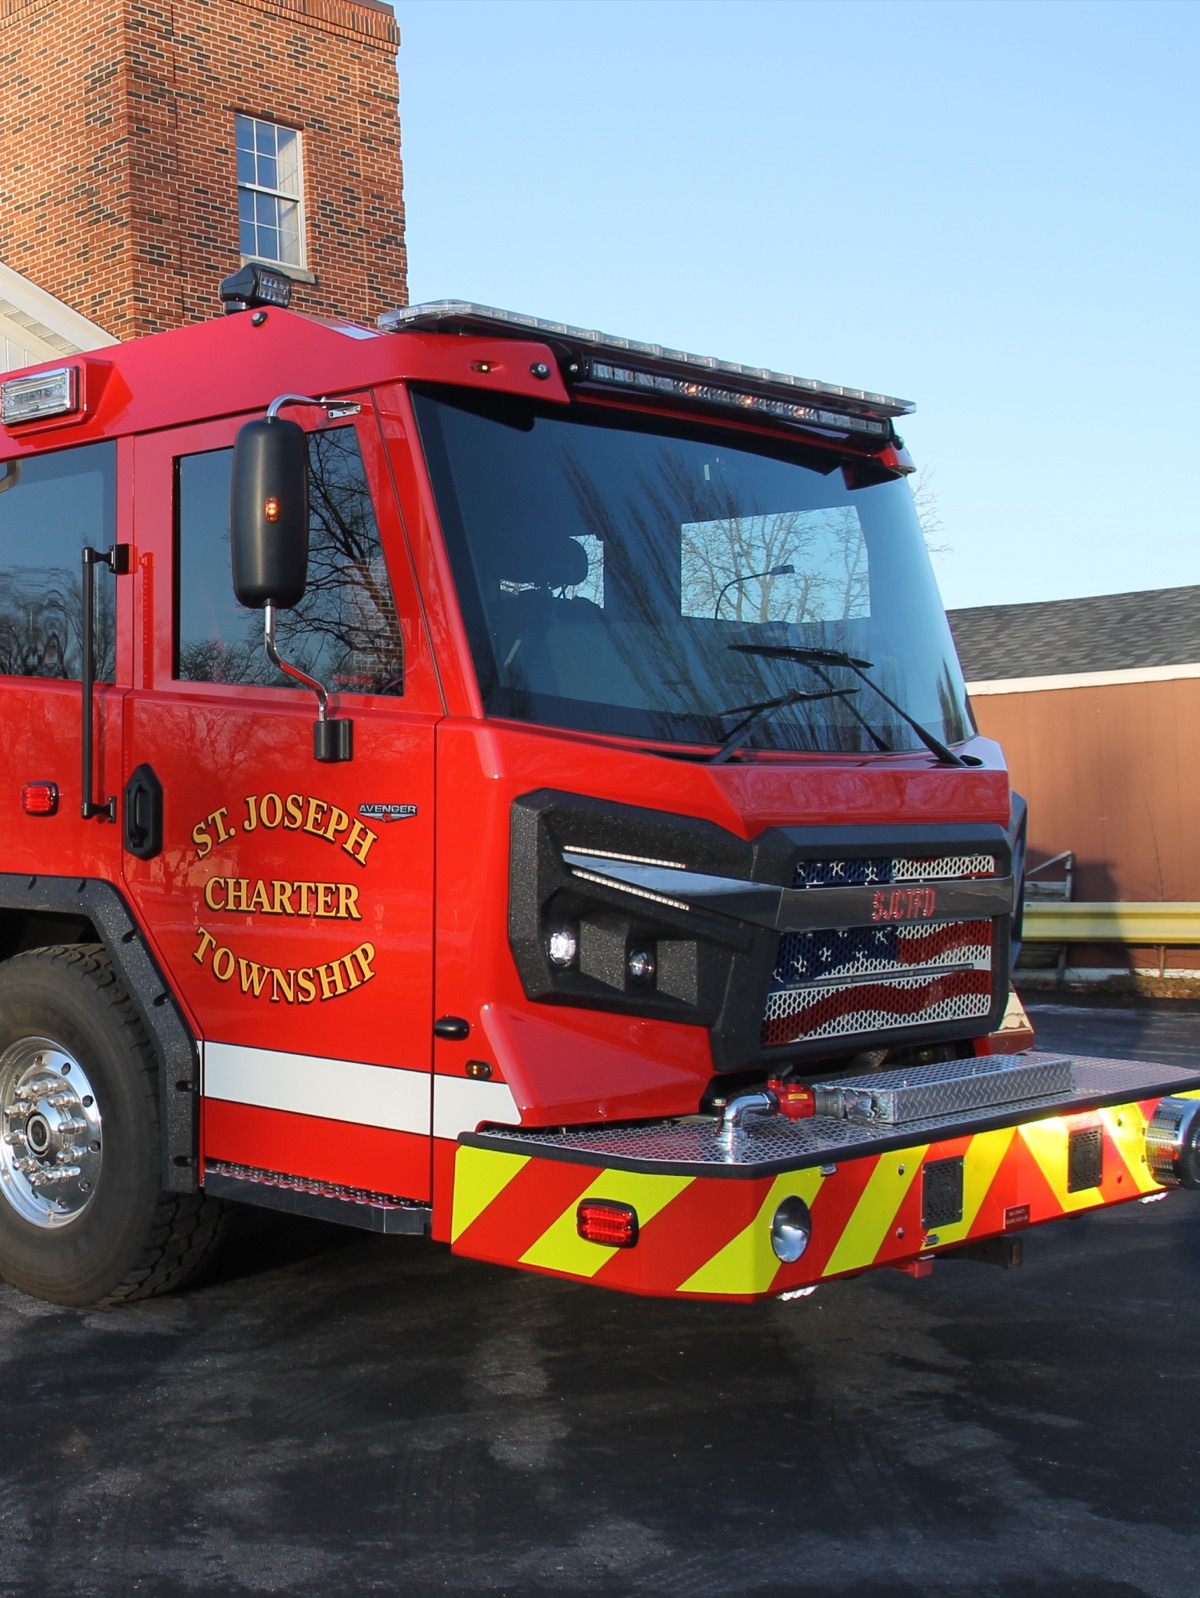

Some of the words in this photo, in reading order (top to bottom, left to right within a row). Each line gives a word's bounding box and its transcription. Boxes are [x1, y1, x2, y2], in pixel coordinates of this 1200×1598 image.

[191, 807, 236, 859] ST.
[242, 793, 378, 866] JOSEPH
[359, 804, 417, 813] AVENGER
[205, 876, 362, 920] CHARTER
[871, 887, 937, 921] SJCTFD
[192, 926, 377, 1004] TOWNSHIP
